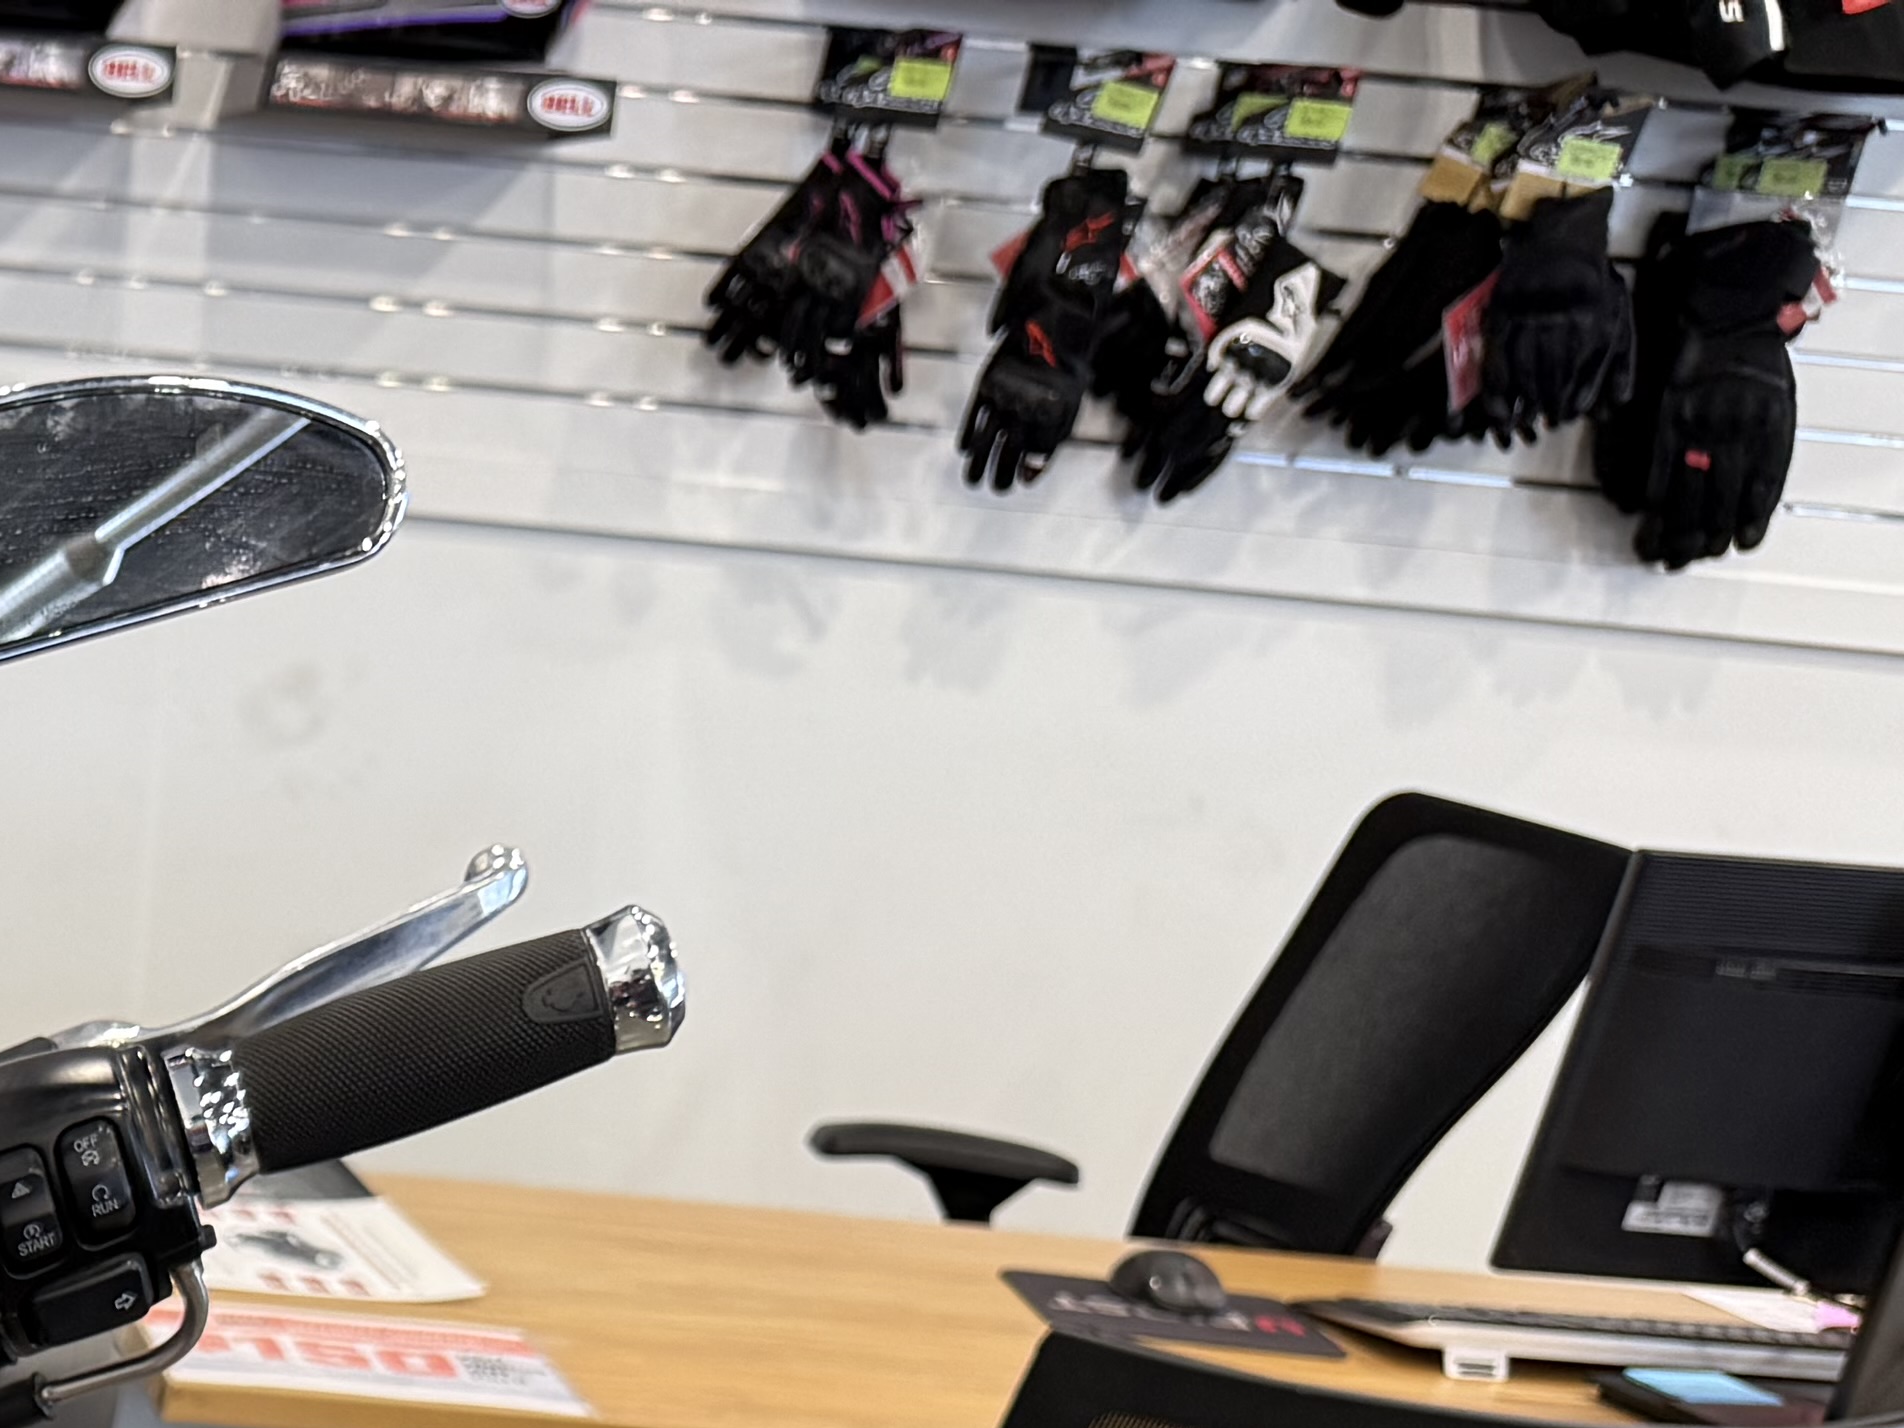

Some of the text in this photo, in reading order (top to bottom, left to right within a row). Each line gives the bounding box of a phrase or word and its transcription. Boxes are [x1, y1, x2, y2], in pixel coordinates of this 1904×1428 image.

[73, 1133, 97, 1153] OFF
[92, 1198, 119, 1217] RUN
[18, 1232, 55, 1256] START
